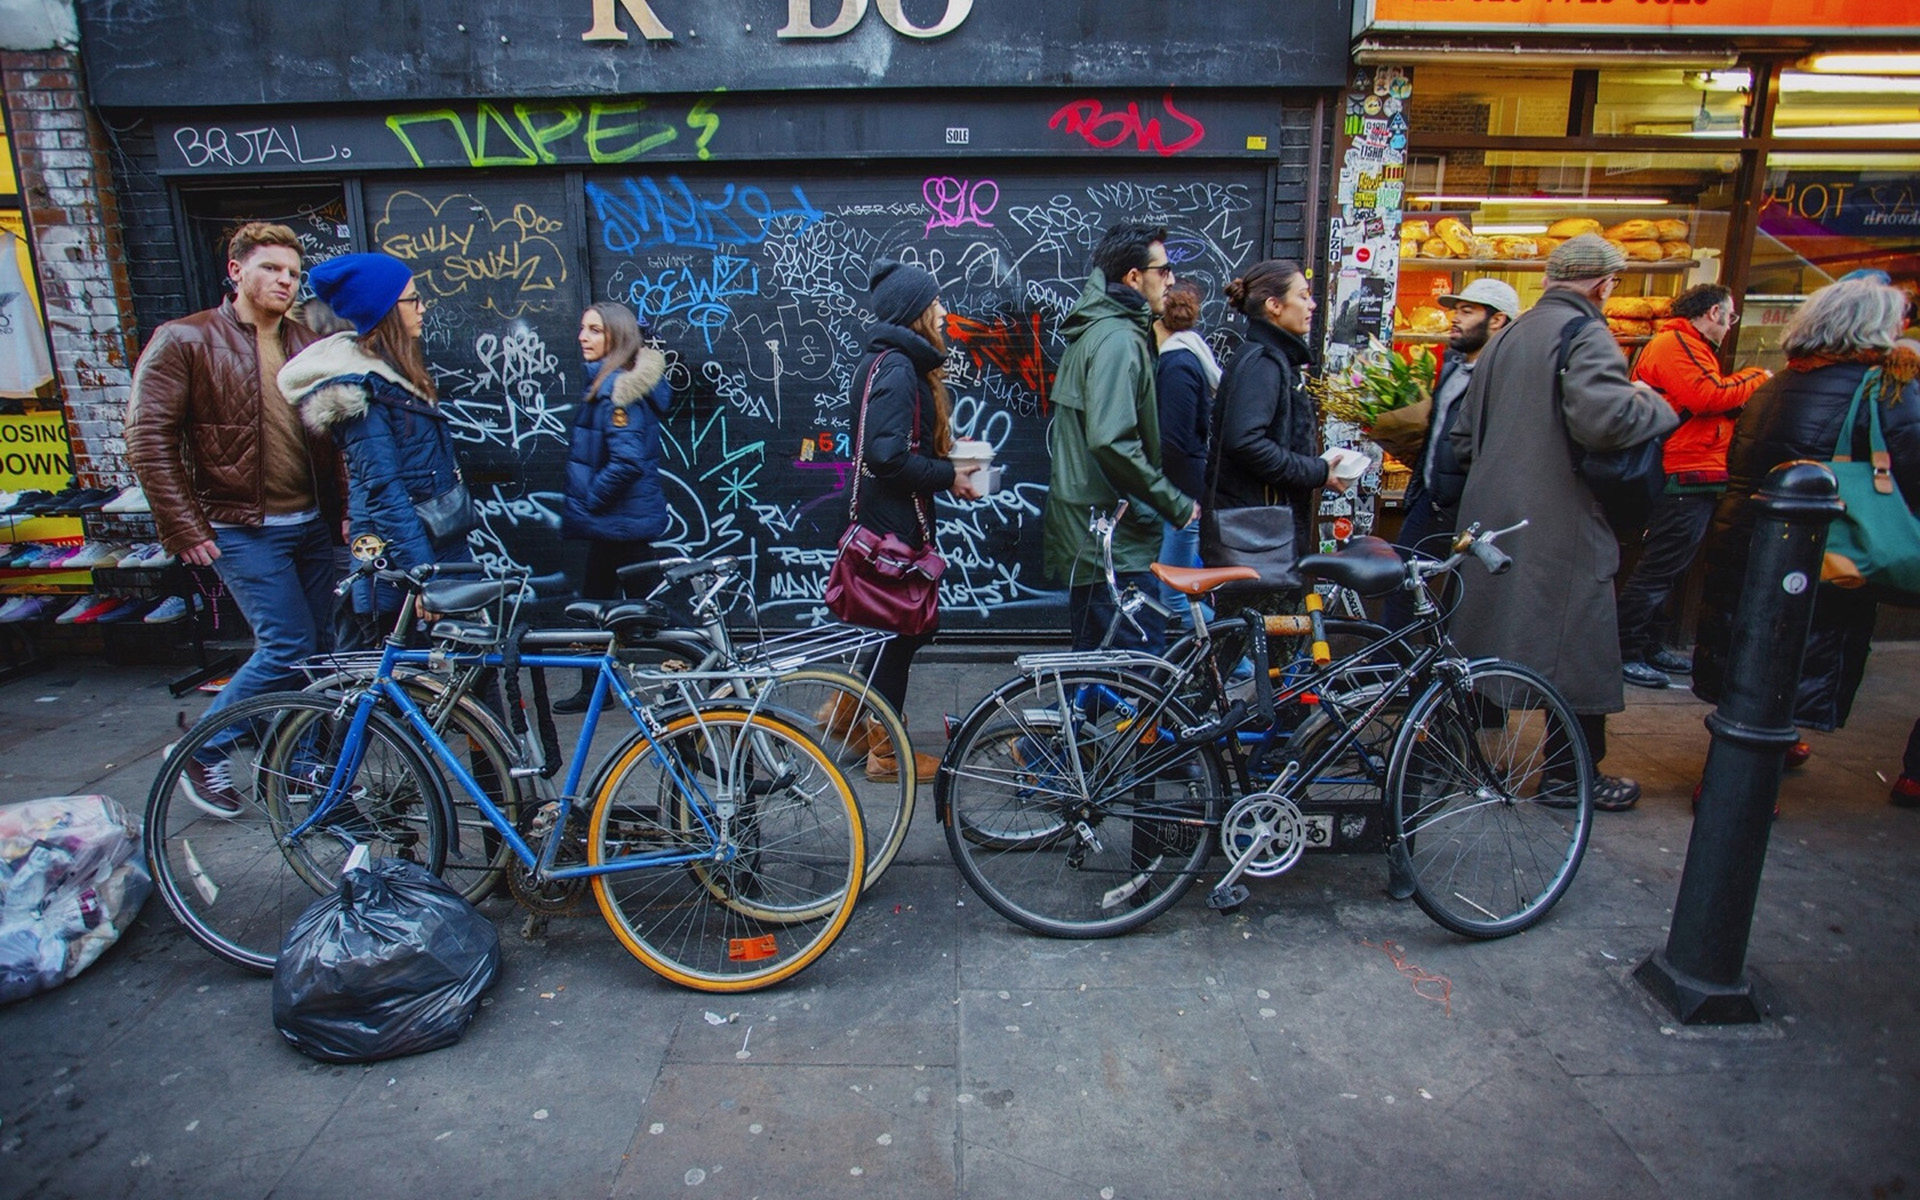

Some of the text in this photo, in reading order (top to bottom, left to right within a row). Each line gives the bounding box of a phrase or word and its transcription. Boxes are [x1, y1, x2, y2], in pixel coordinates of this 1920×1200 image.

[946, 128, 969, 143] SOLE
[1757, 182, 1855, 219] HOT
[1329, 219, 1341, 261] ALZO
